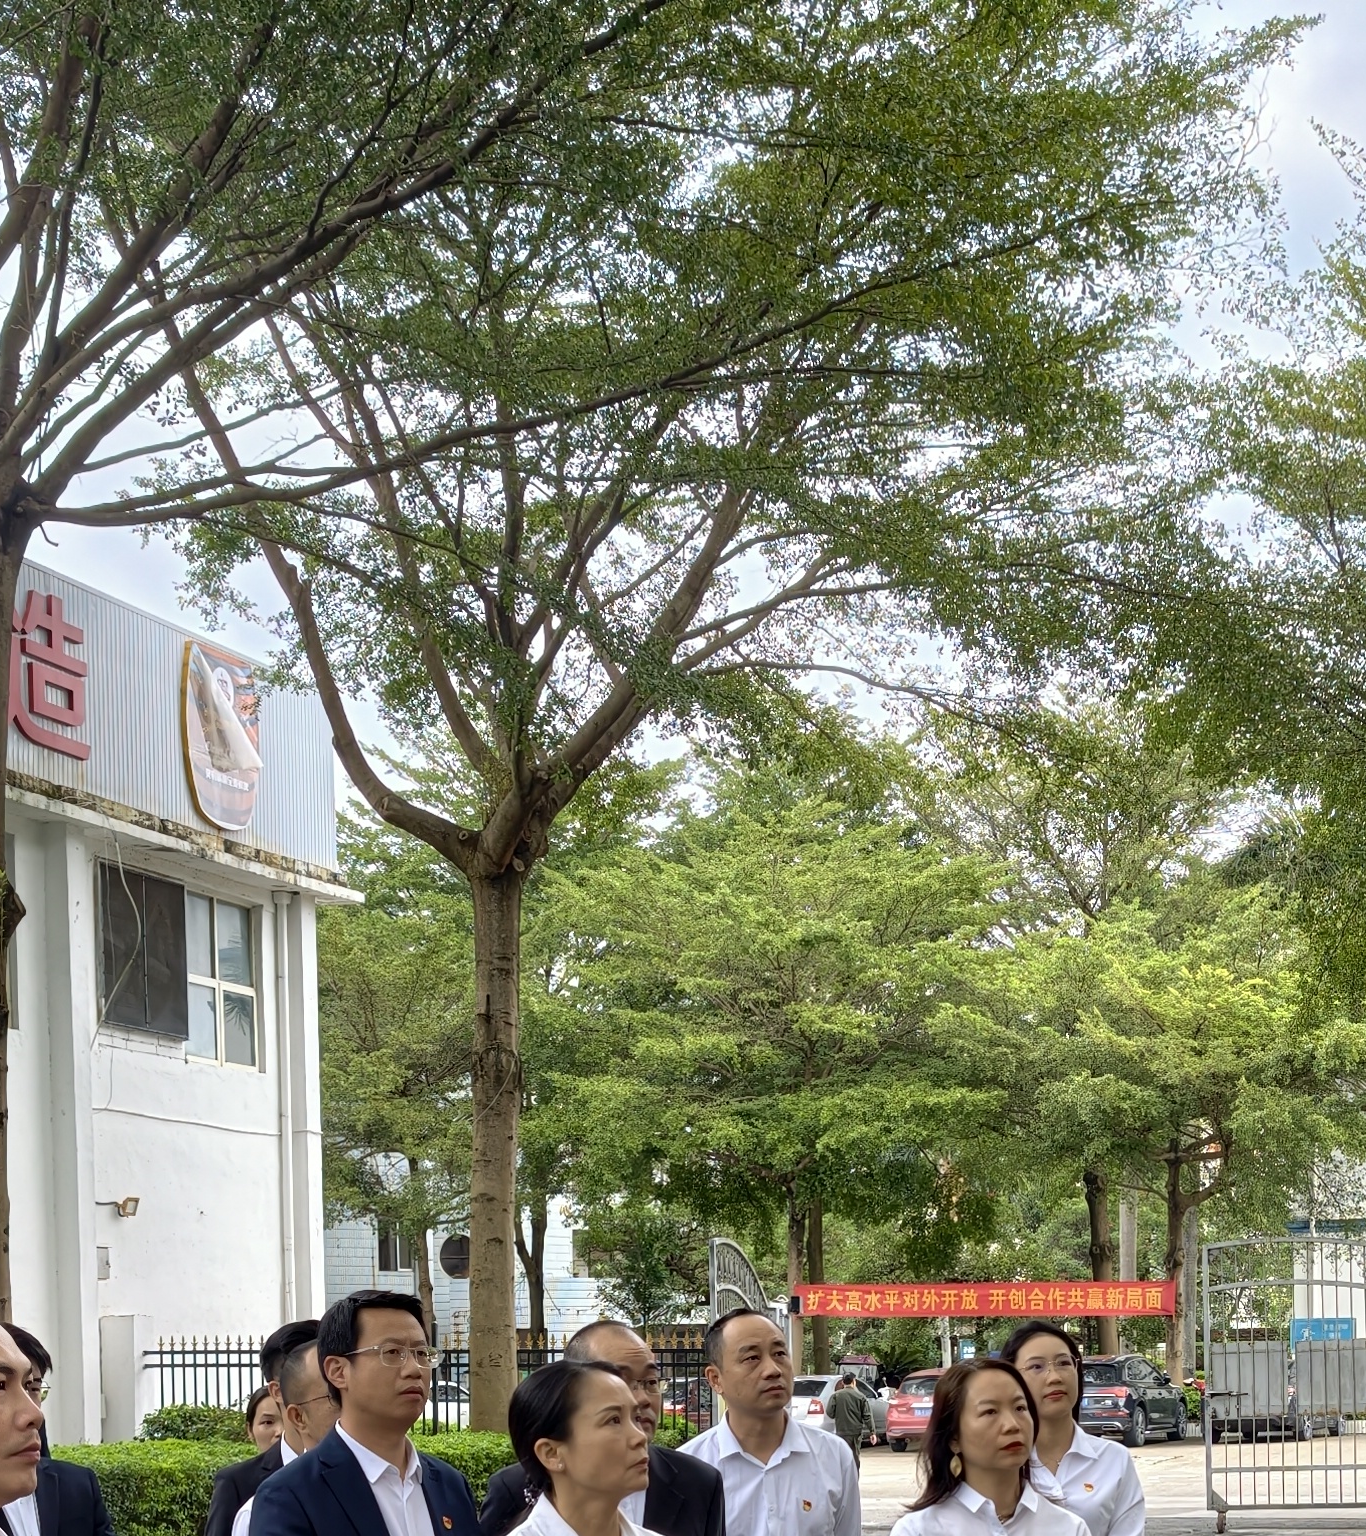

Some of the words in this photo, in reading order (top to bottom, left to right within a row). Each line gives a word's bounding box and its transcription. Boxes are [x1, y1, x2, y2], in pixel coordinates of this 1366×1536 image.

[807, 1289, 979, 1312] 扩大高水平对外开放
[988, 1287, 1163, 1310] 开创合作共赢新局面
